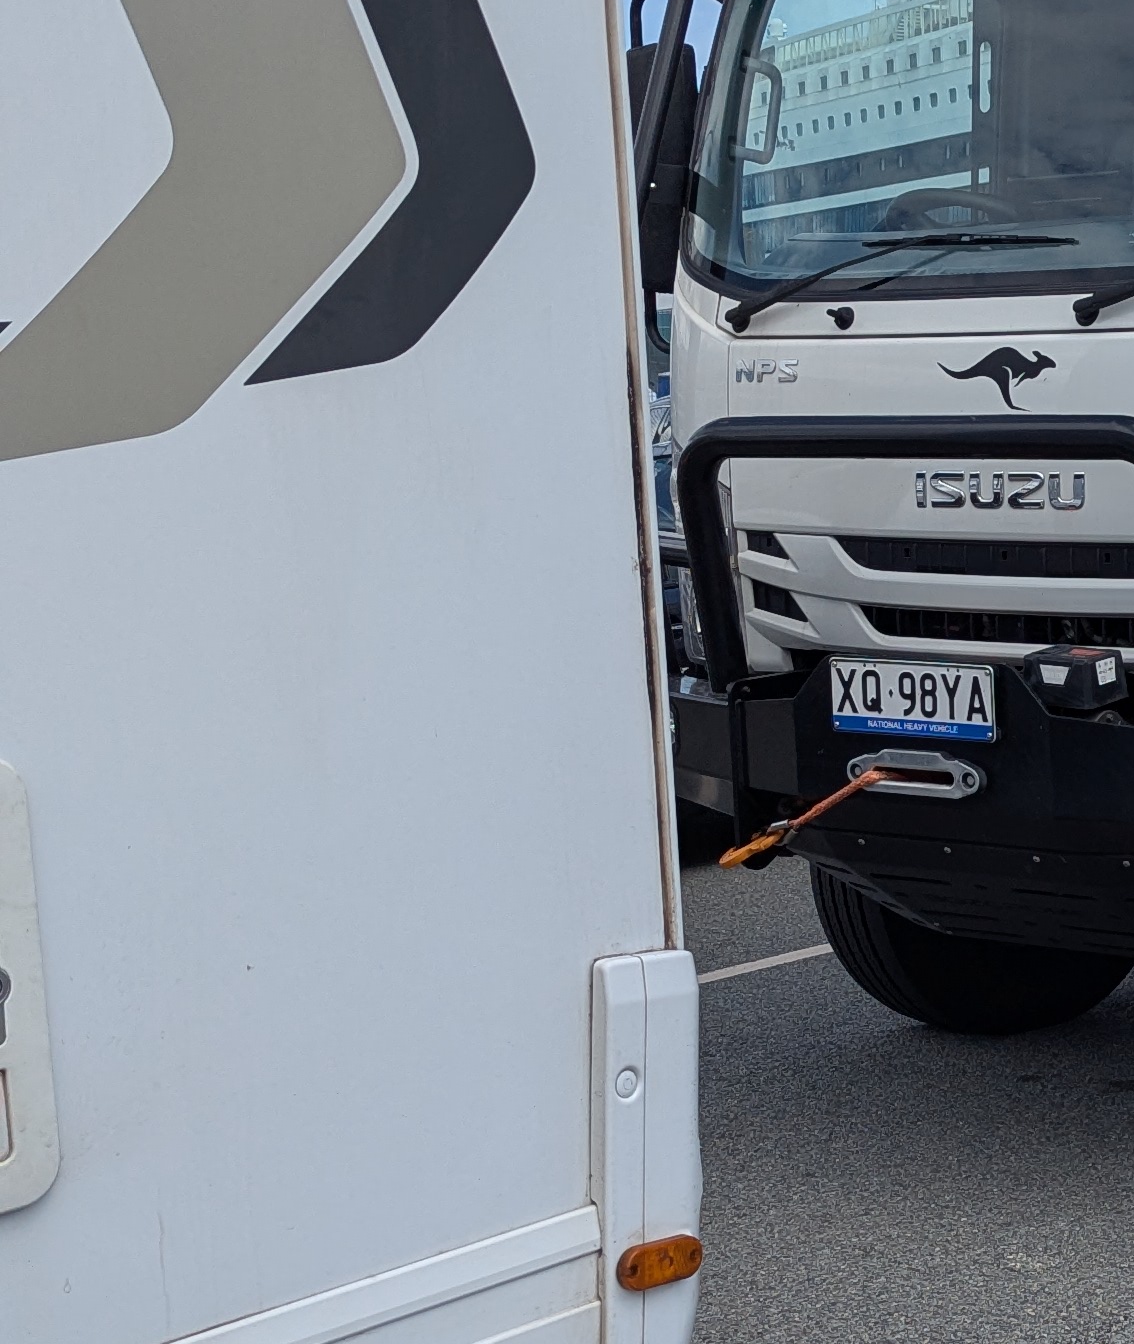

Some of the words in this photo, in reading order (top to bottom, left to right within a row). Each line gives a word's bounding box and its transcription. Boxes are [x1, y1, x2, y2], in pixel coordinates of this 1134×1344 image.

[735, 358, 799, 384] NPS
[915, 470, 1086, 510] ISUZU
[867, 719, 903, 730] NATIONAL
[903, 721, 928, 732] HEAVY
[928, 724, 959, 734] VEHICLE
